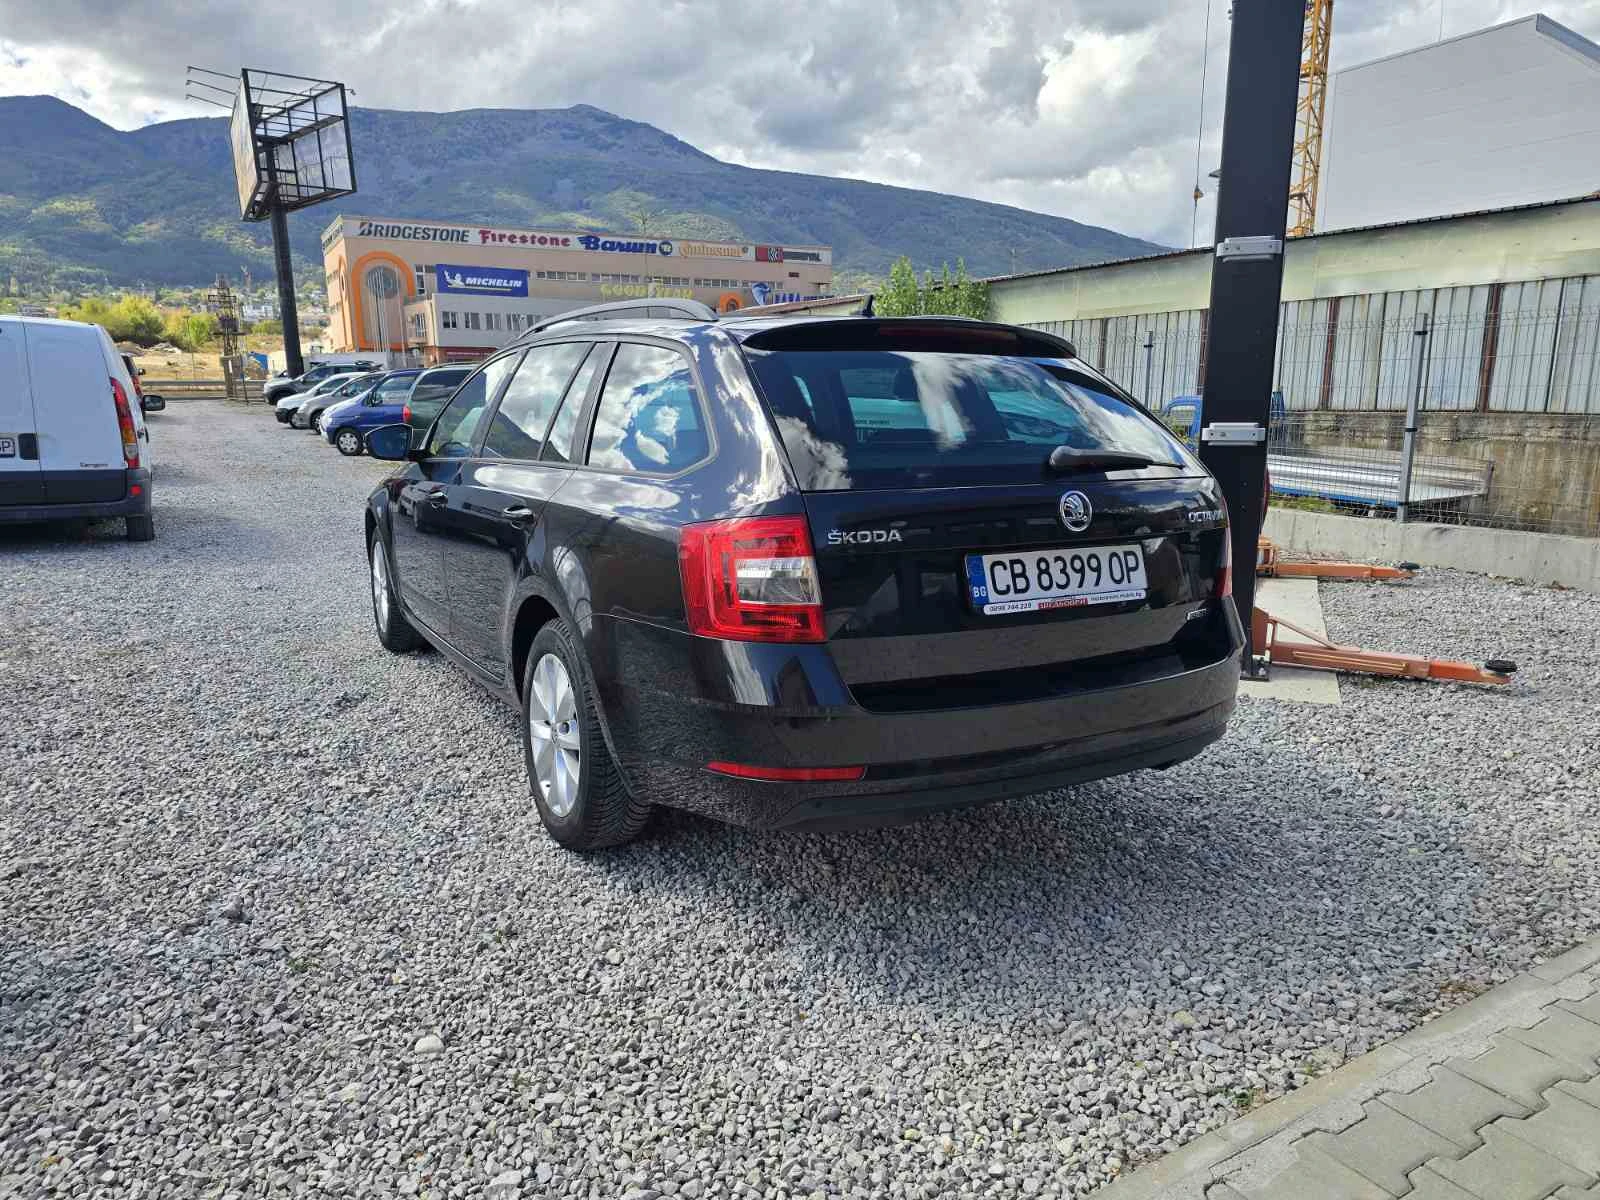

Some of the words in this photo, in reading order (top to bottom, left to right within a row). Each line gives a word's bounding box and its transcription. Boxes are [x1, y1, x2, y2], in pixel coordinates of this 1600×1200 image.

[359, 222, 470, 243] BRIDGESTONE
[478, 229, 571, 248] Firestone
[465, 276, 523, 288] MICHELIN
[827, 529, 904, 545] ŠKODA
[989, 558, 1031, 596] CB
[1036, 552, 1101, 592] 8399
[972, 585, 987, 598] BG
